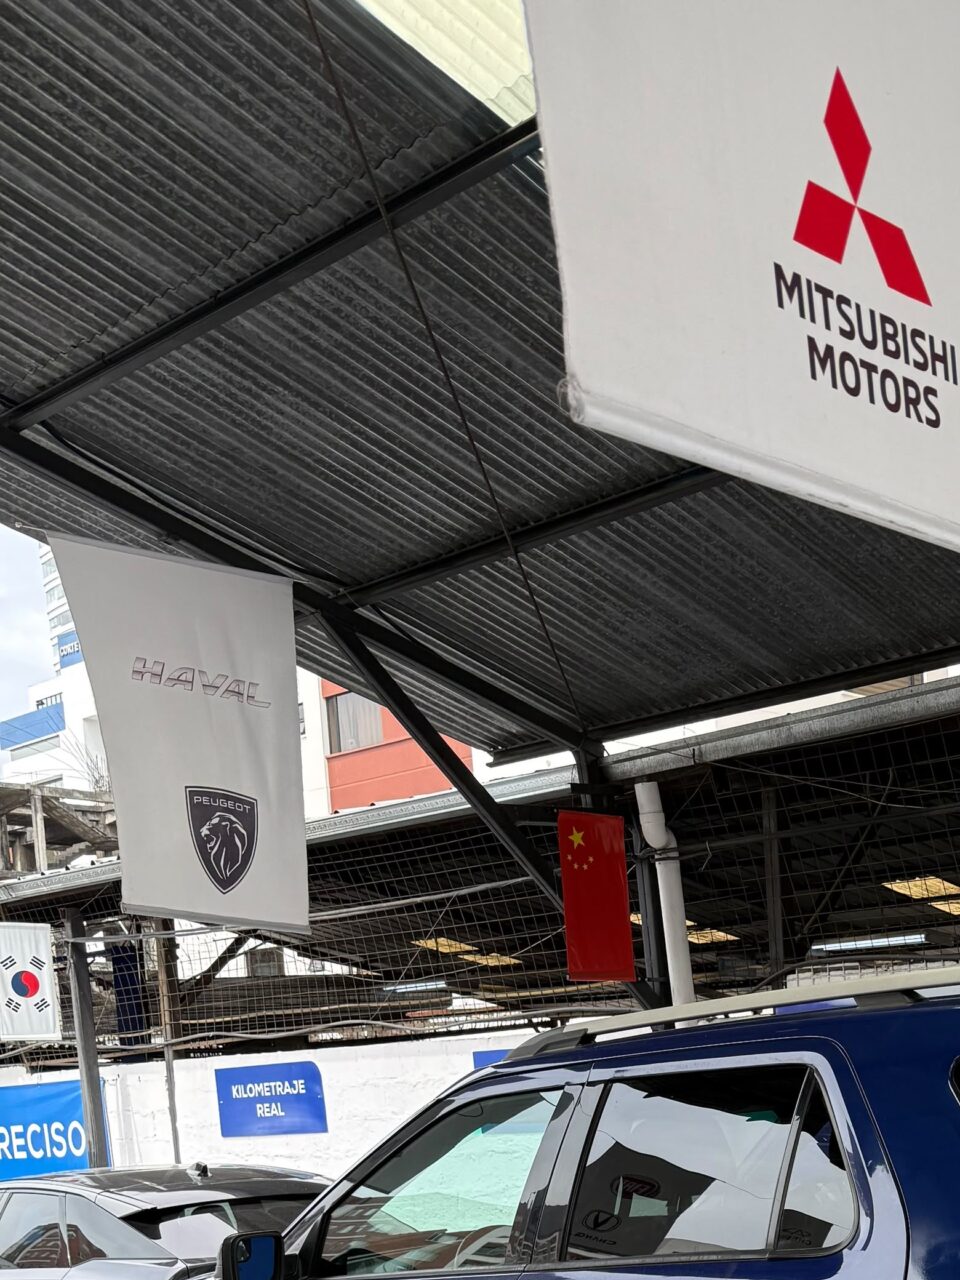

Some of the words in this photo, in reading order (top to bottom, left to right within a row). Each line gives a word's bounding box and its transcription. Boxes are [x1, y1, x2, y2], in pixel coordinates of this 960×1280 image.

[773, 261, 958, 386] MITSUBISHI
[806, 334, 941, 429] MOTORS
[131, 656, 272, 709] HAVAL
[193, 796, 251, 813] PEUGEOT
[231, 1079, 307, 1099] KILOMETRAJE
[256, 1102, 286, 1118] REAL
